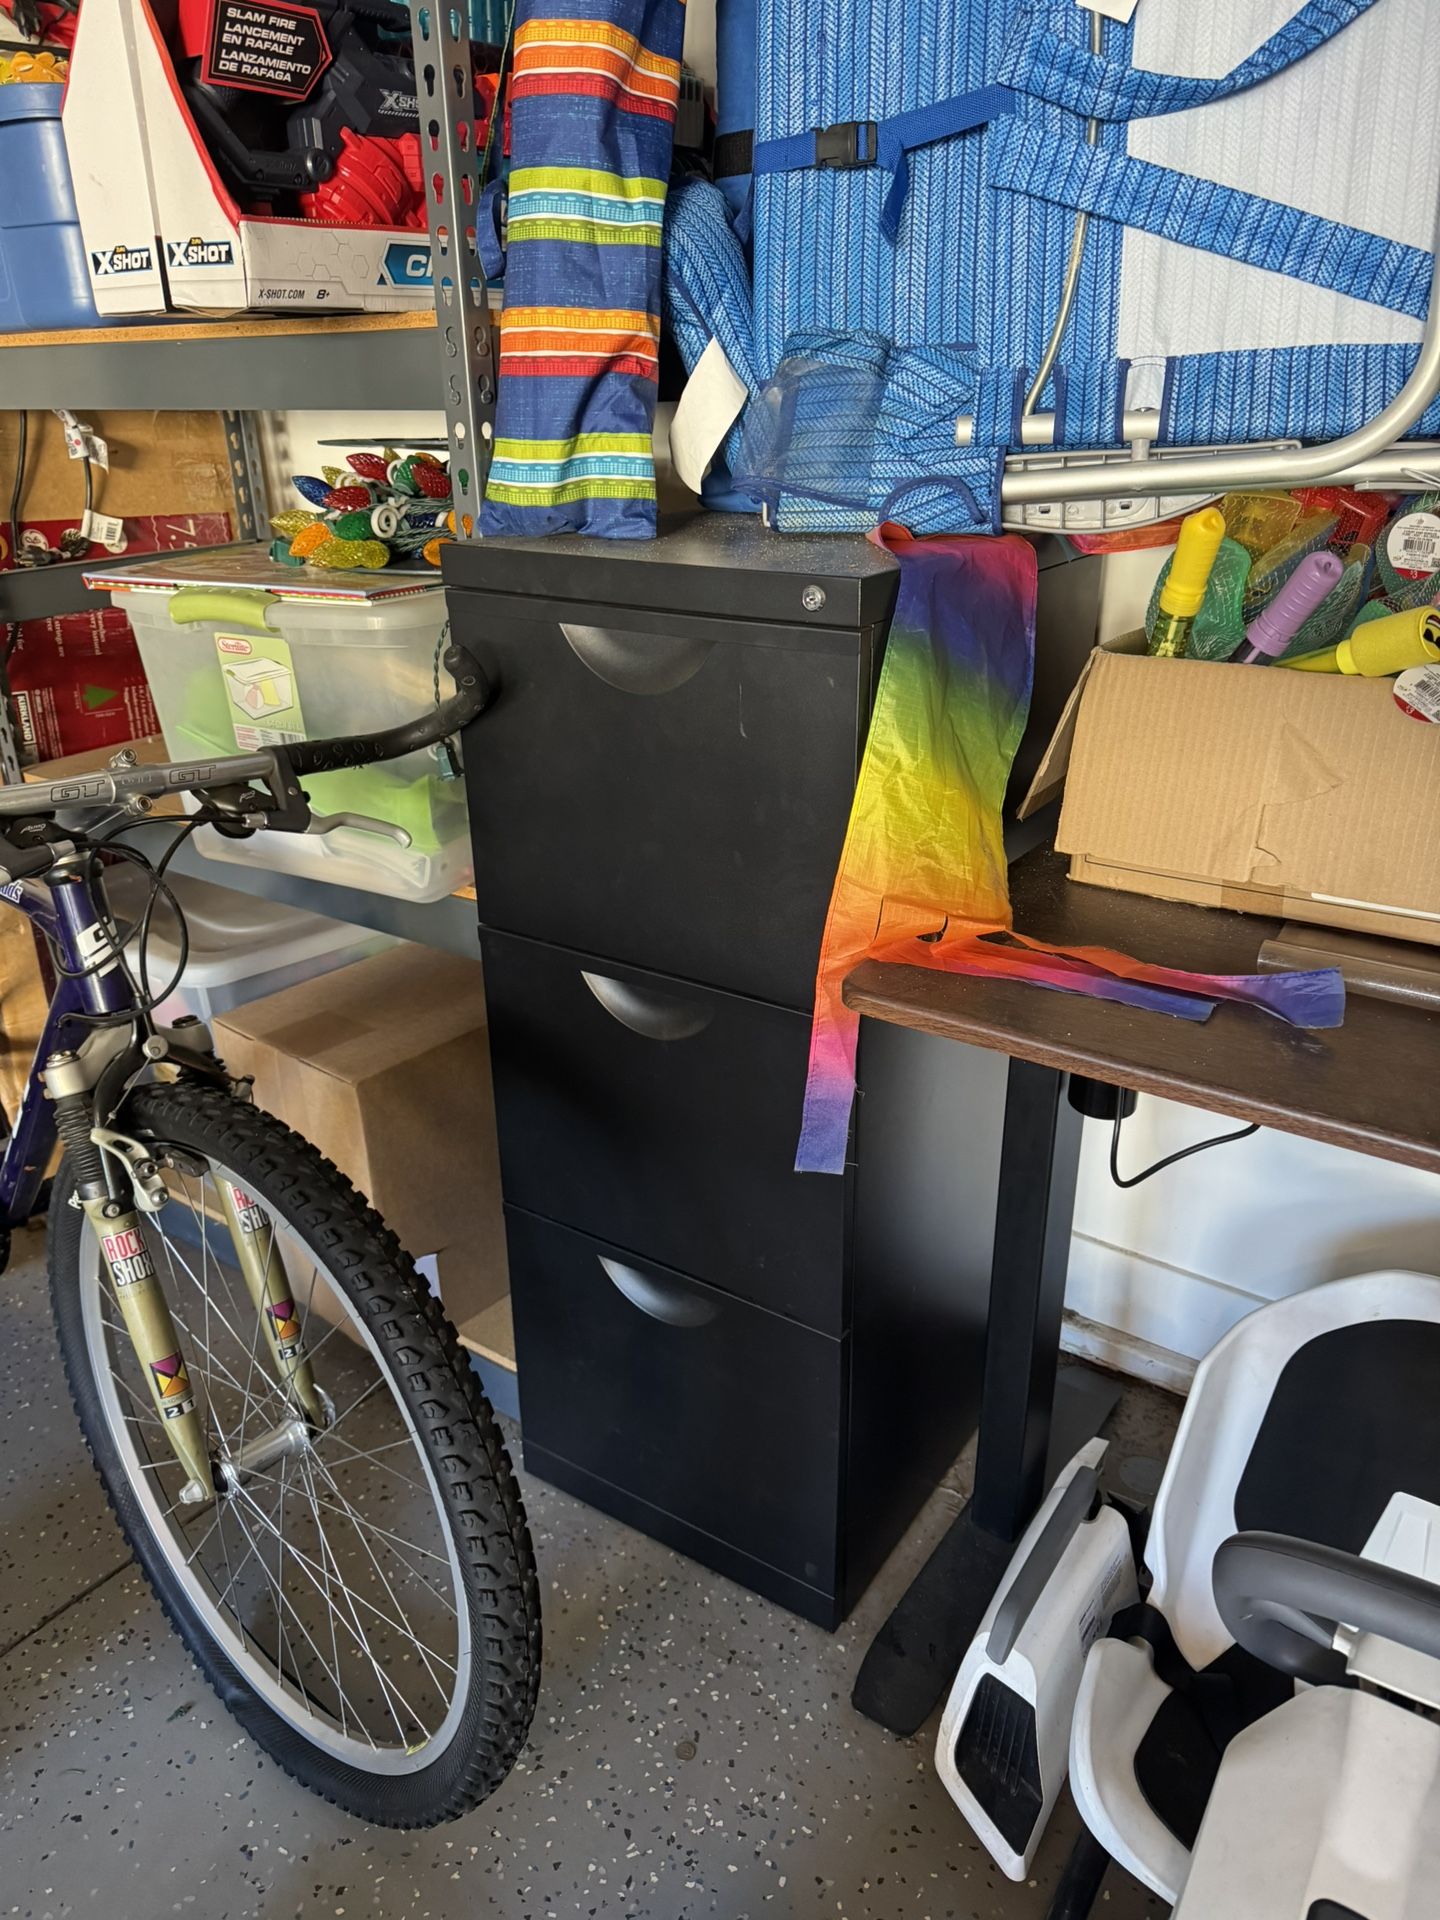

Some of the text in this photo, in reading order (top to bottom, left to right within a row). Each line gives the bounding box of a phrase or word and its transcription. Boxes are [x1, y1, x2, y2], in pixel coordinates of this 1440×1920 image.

[226, 7, 297, 30] SLAM FIRE
[222, 33, 295, 55] EN RAFALE
[224, 22, 305, 46] LANCEMENT
[218, 60, 291, 82] DE RAFAGA
[221, 49, 311, 75] LANZAMIENTO
[258, 288, 331, 300] X-SHOT.COM 8+
[17, 695, 32, 741] KIRKLAND
[169, 764, 217, 785] GT
[50, 779, 106, 803] GT
[105, 1228, 145, 1261] ROCK
[112, 1253, 155, 1286] SHOX
